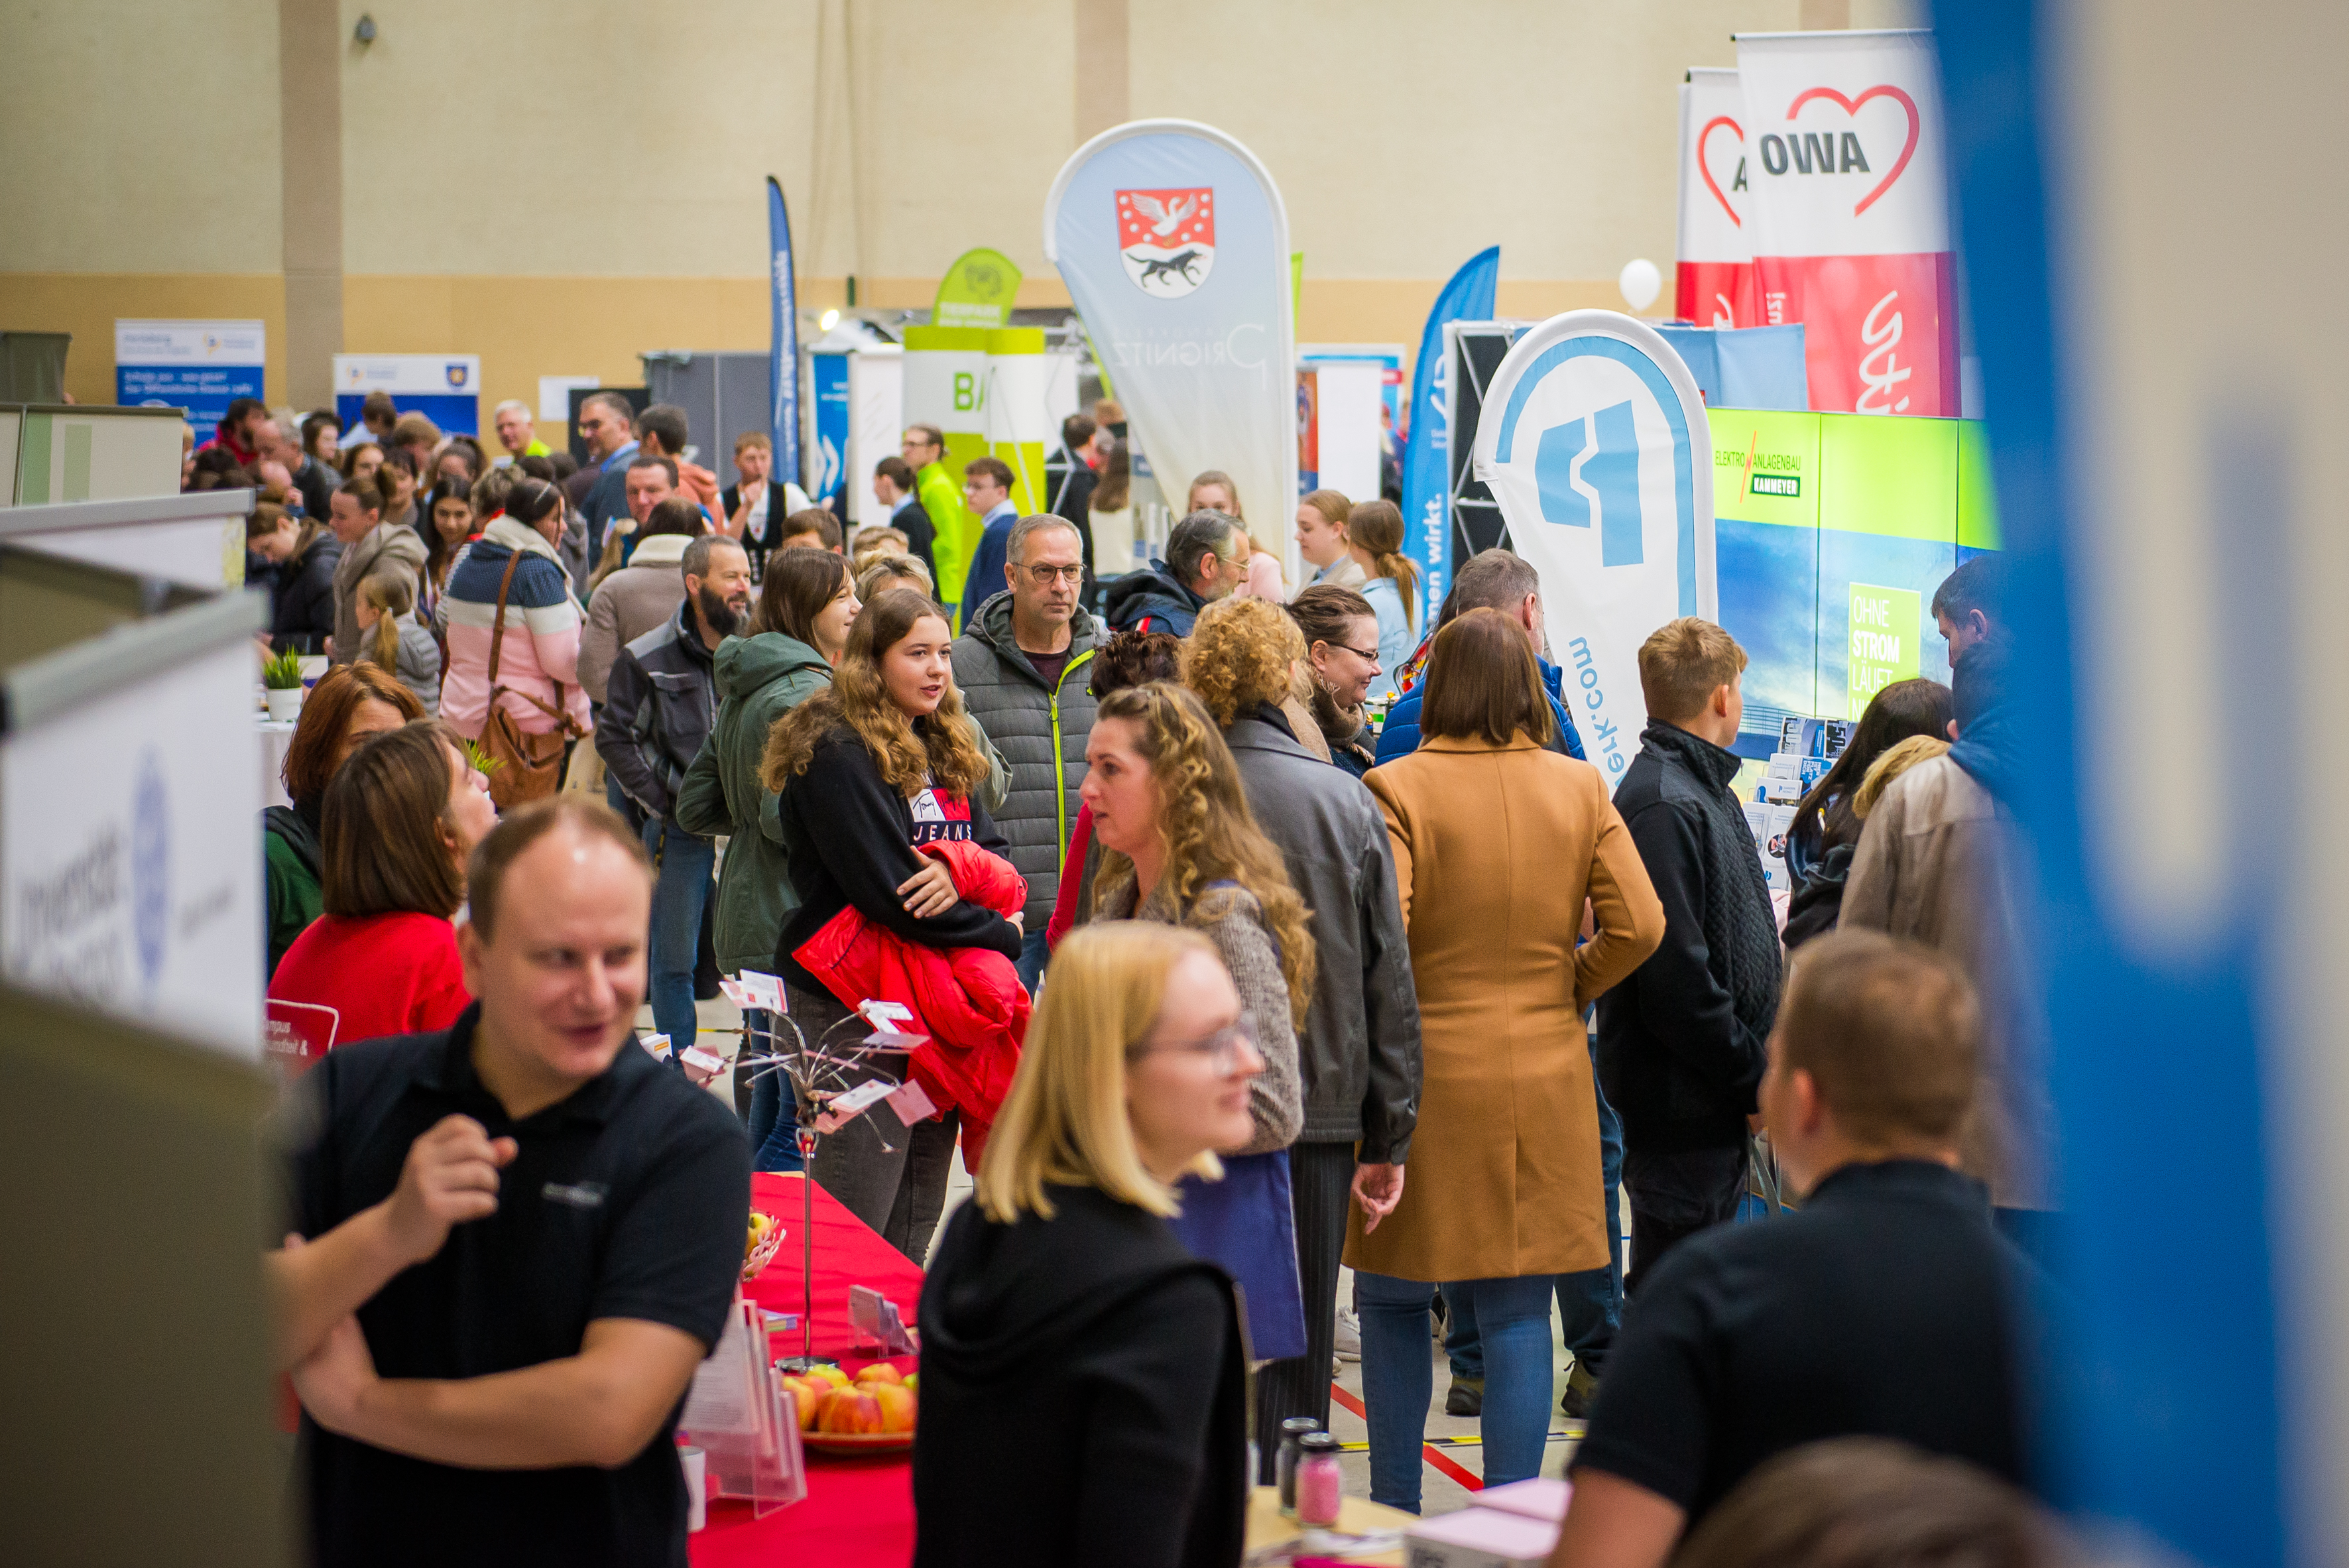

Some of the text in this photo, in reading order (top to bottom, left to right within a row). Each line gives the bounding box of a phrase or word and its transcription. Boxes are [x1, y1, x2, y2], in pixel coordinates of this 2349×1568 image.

[1715, 450, 1801, 471] ELEKTRO ANLAGENBAU
[1753, 477, 1797, 495] KAMMEYER
[1423, 493, 1442, 564] wirkt.
[1853, 595, 1890, 627] OHNE
[1852, 629, 1900, 664] STROM
[1852, 660, 1894, 694] LÄUFT
[913, 824, 971, 841] JEANS
